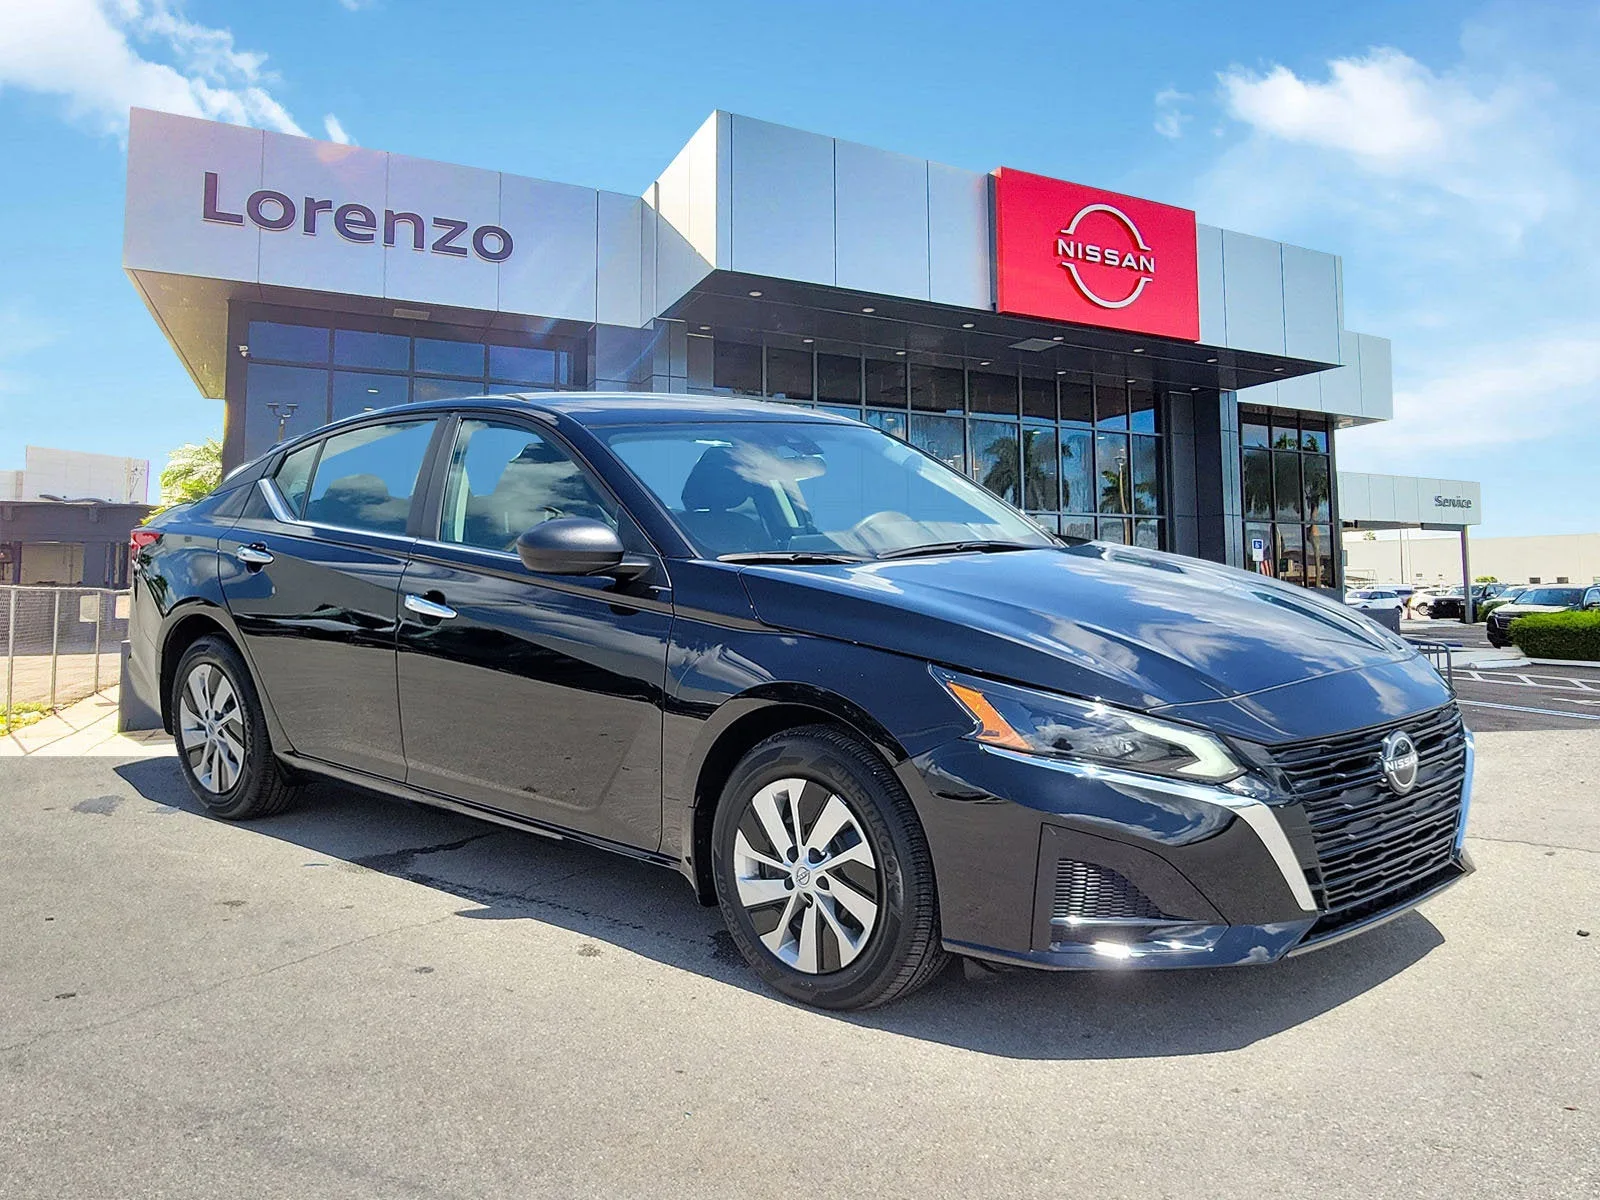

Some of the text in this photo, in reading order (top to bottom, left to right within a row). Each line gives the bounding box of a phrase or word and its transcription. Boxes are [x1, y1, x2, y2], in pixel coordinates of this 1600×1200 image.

[202, 171, 514, 263] Lorenzo
[1056, 239, 1155, 273] NISSAN
[1434, 496, 1471, 509] Service
